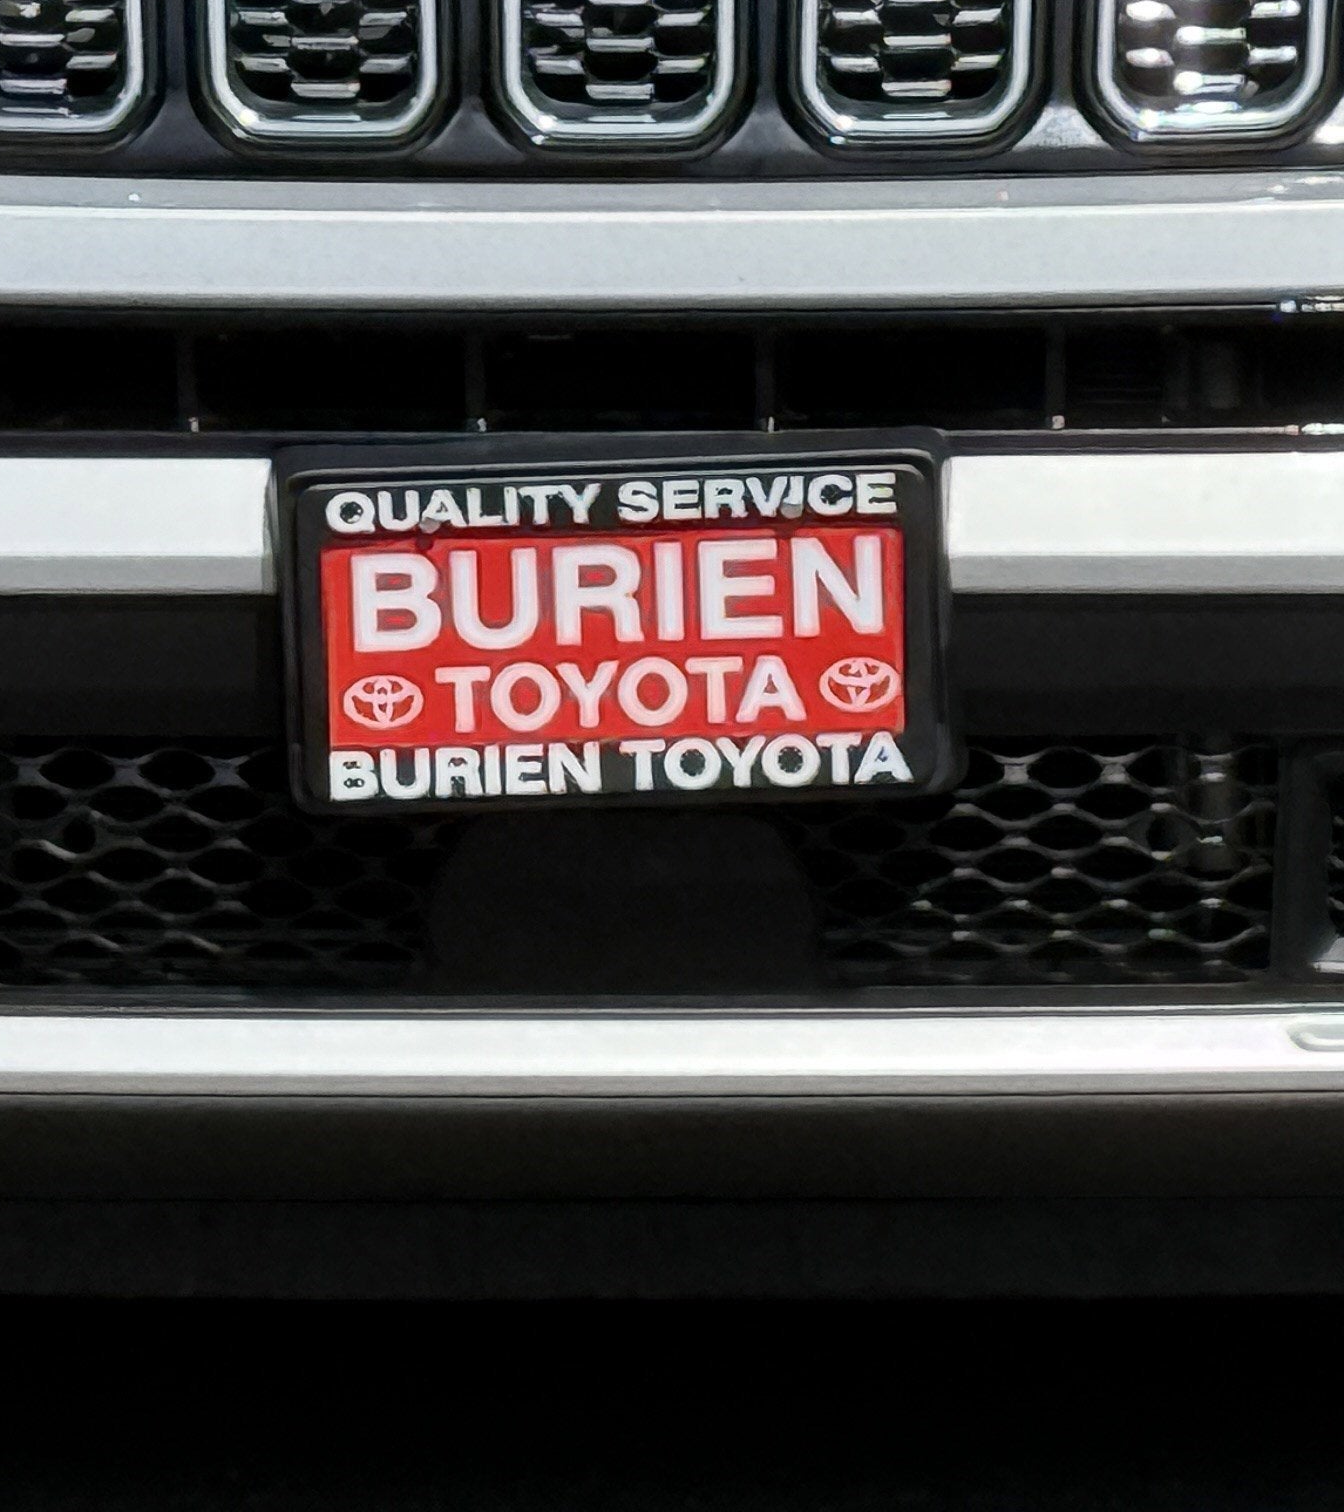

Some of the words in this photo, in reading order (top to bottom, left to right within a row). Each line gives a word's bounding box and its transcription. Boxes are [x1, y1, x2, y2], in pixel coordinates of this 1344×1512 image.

[325, 484, 601, 533] QUALITY
[617, 472, 899, 522] SERVICE
[350, 535, 884, 652] BURIEN
[435, 656, 807, 732] TOYOTA
[330, 743, 602, 801] BURIEN
[618, 731, 914, 790] TOYOTA
